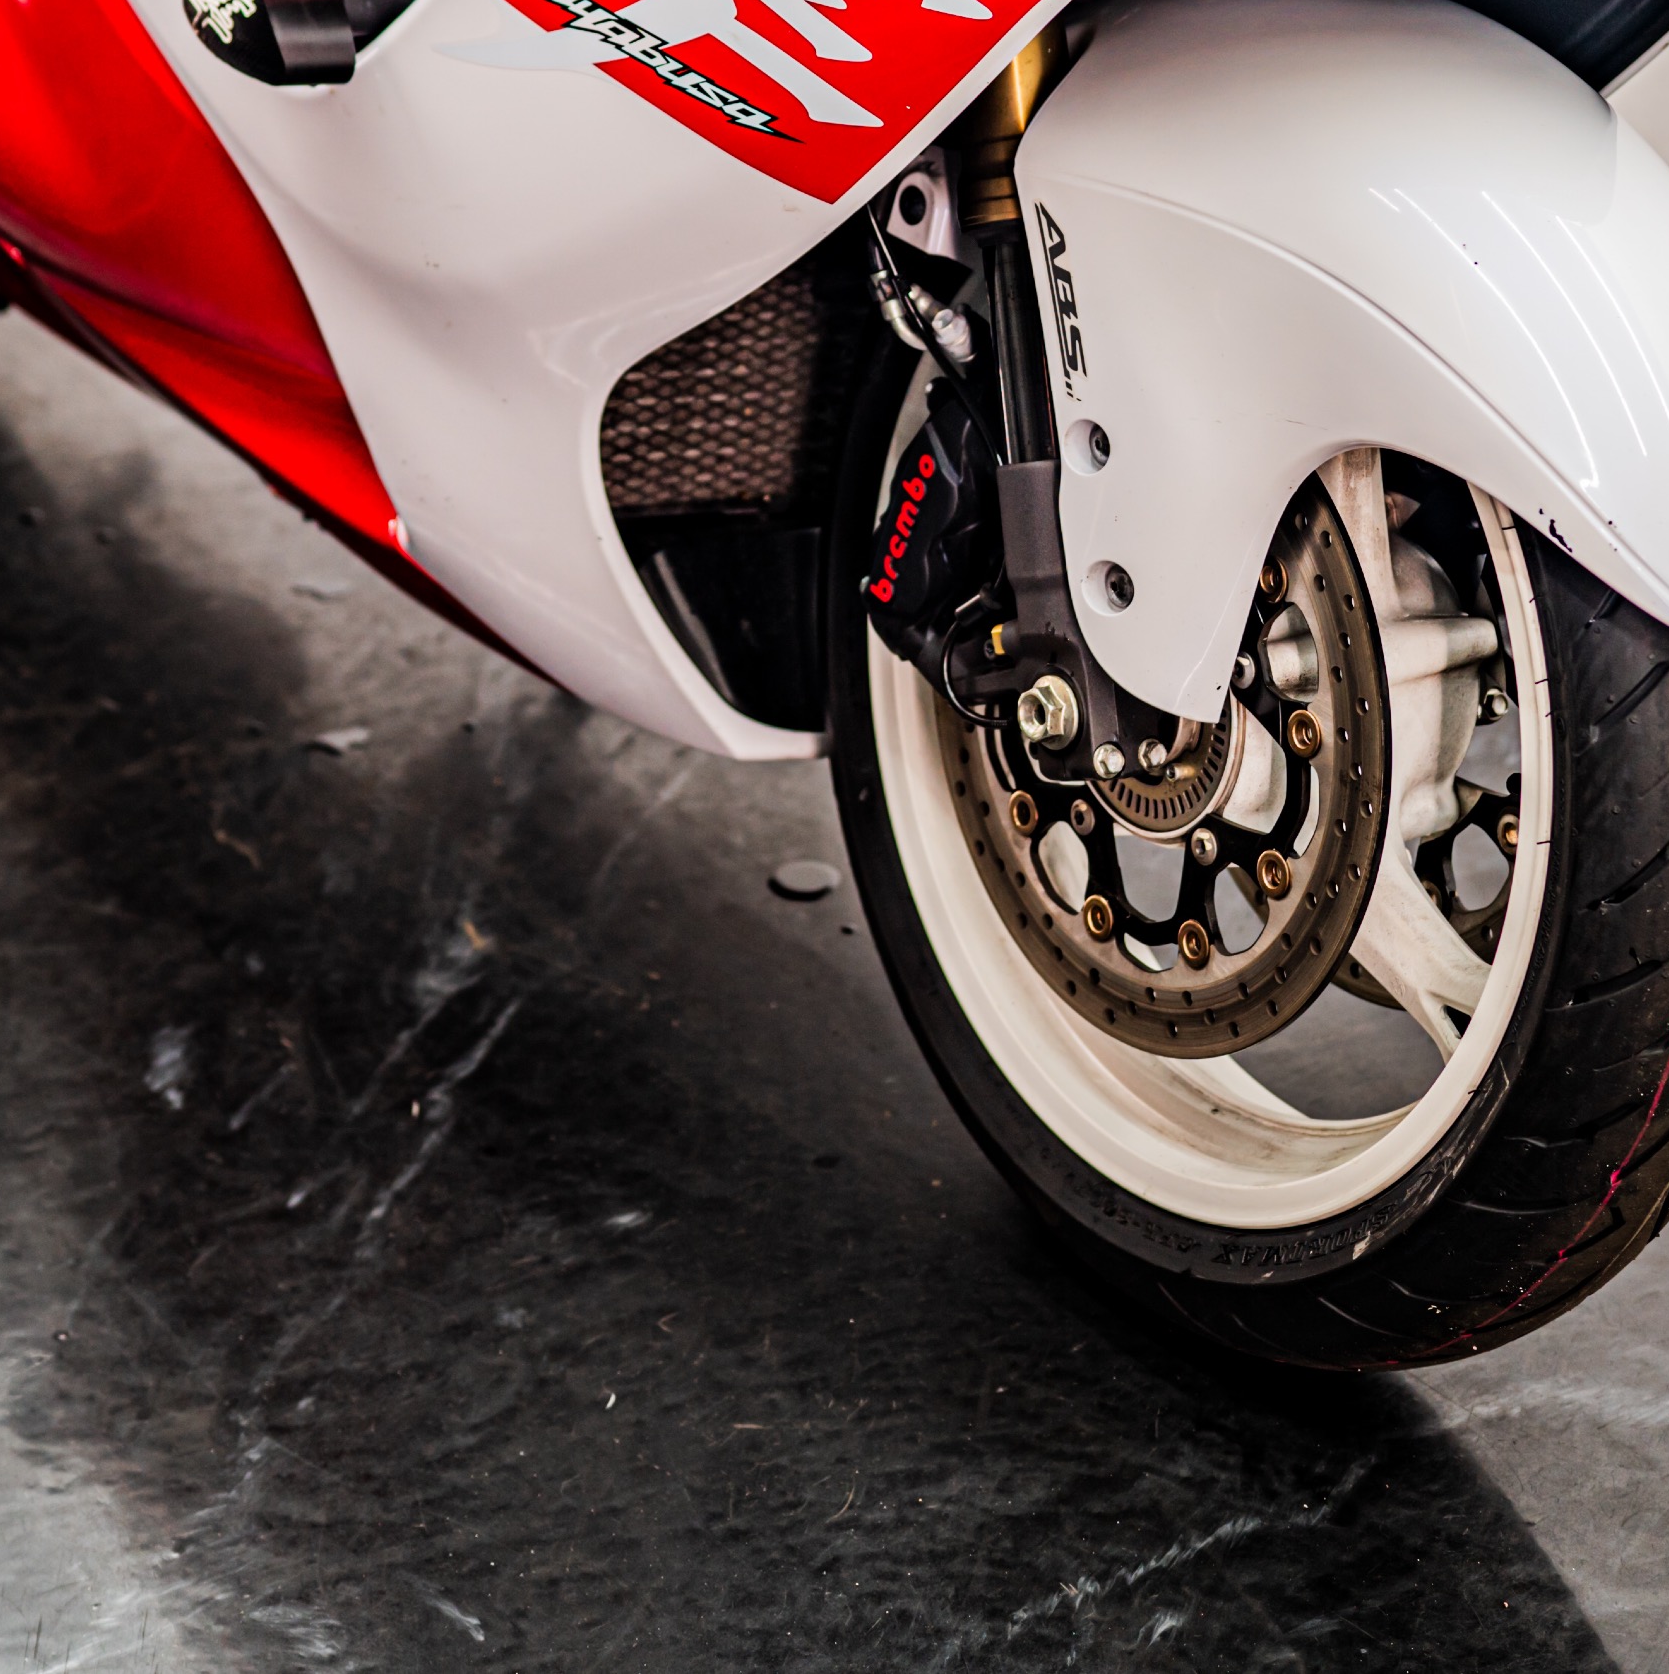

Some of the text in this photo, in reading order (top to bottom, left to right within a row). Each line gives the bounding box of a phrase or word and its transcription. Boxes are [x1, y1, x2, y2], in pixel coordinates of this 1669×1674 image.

[1035, 201, 1088, 379] ABS
[870, 454, 935, 603] brembo
[1212, 1203, 1396, 1267] SPORTMAX
